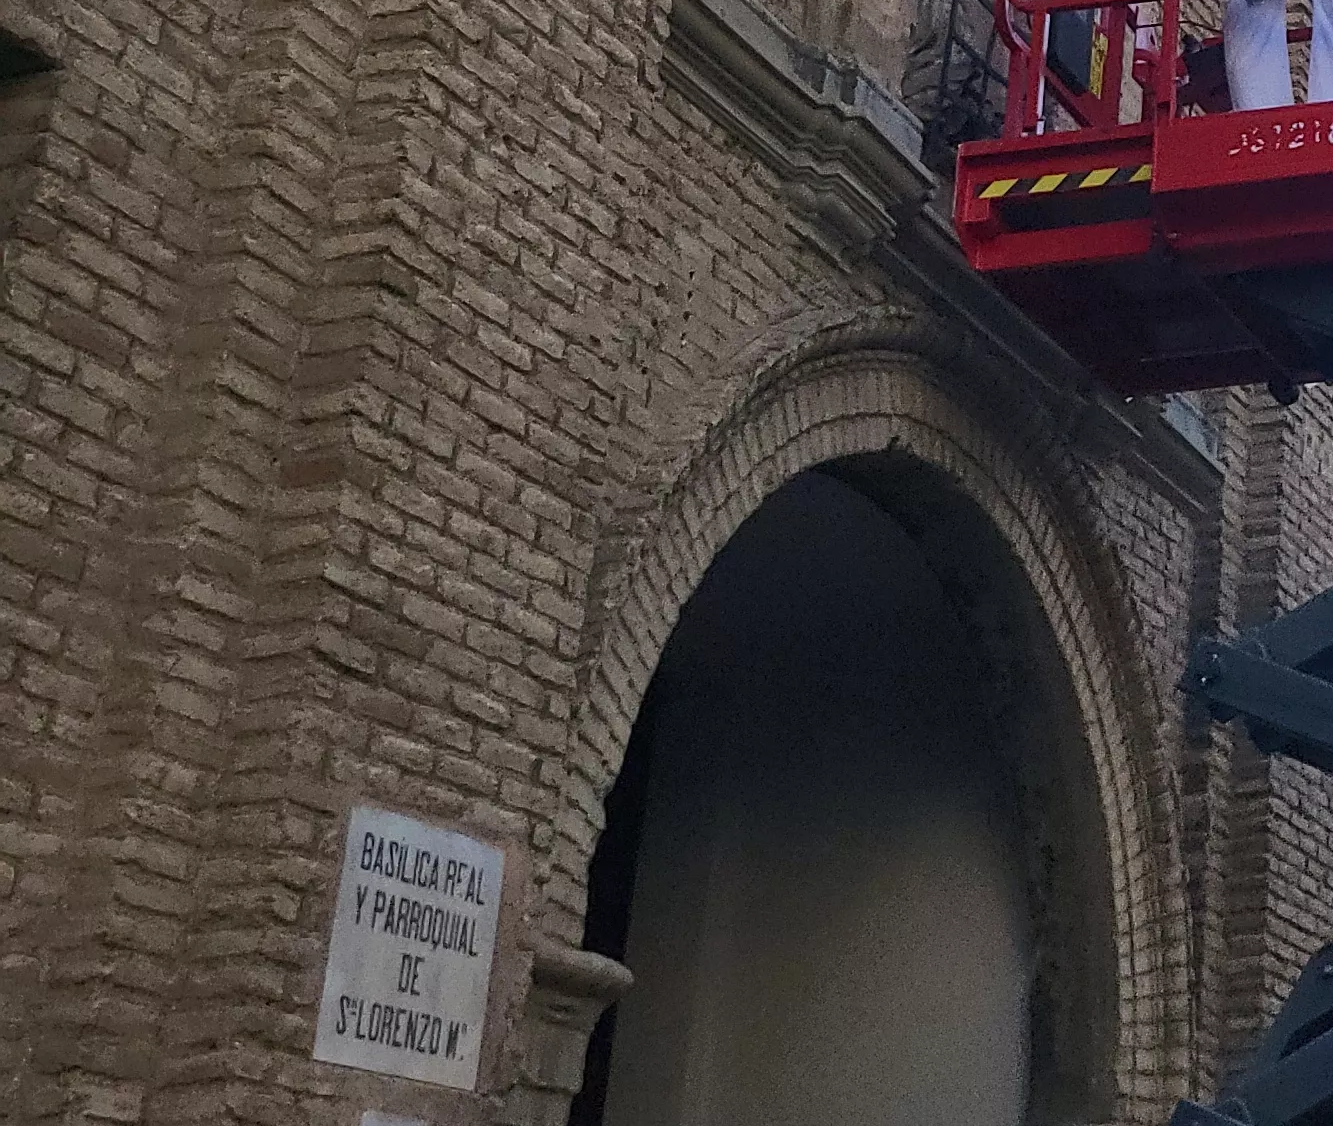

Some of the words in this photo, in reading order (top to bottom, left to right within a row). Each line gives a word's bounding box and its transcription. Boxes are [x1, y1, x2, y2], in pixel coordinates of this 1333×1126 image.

[354, 883, 369, 926] Y
[371, 888, 479, 957] PARROQUIAL
[397, 952, 426, 996] DE
[355, 999, 443, 1055] LORENZO
